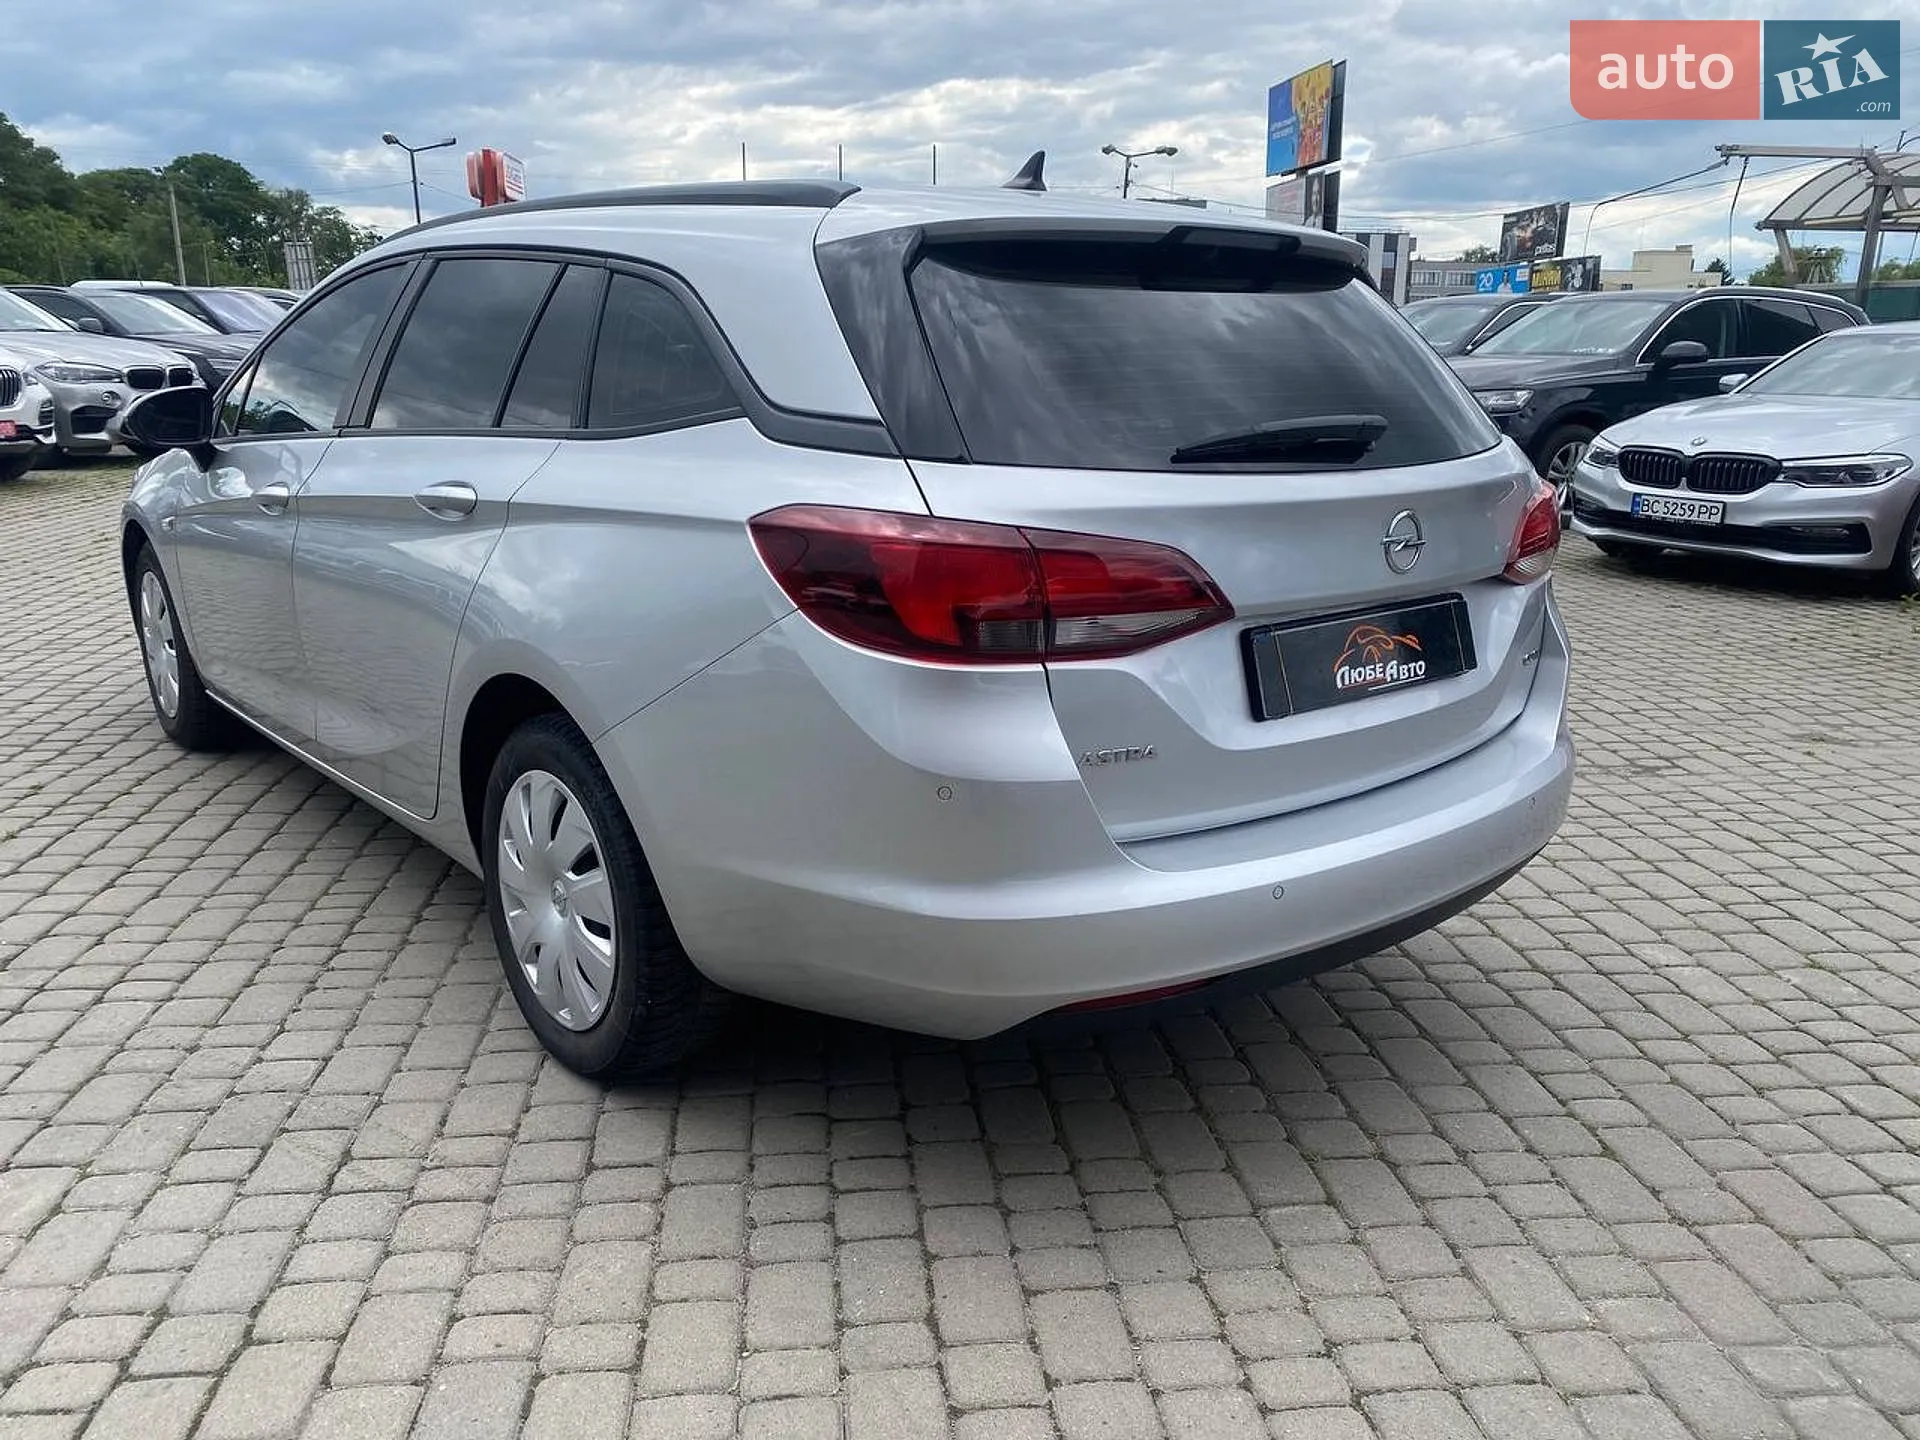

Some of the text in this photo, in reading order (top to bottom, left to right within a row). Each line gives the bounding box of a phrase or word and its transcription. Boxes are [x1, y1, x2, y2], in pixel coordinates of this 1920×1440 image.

[1641, 498, 1661, 514] BC
[1662, 501, 1695, 518] 5259
[1697, 504, 1720, 520] PP
